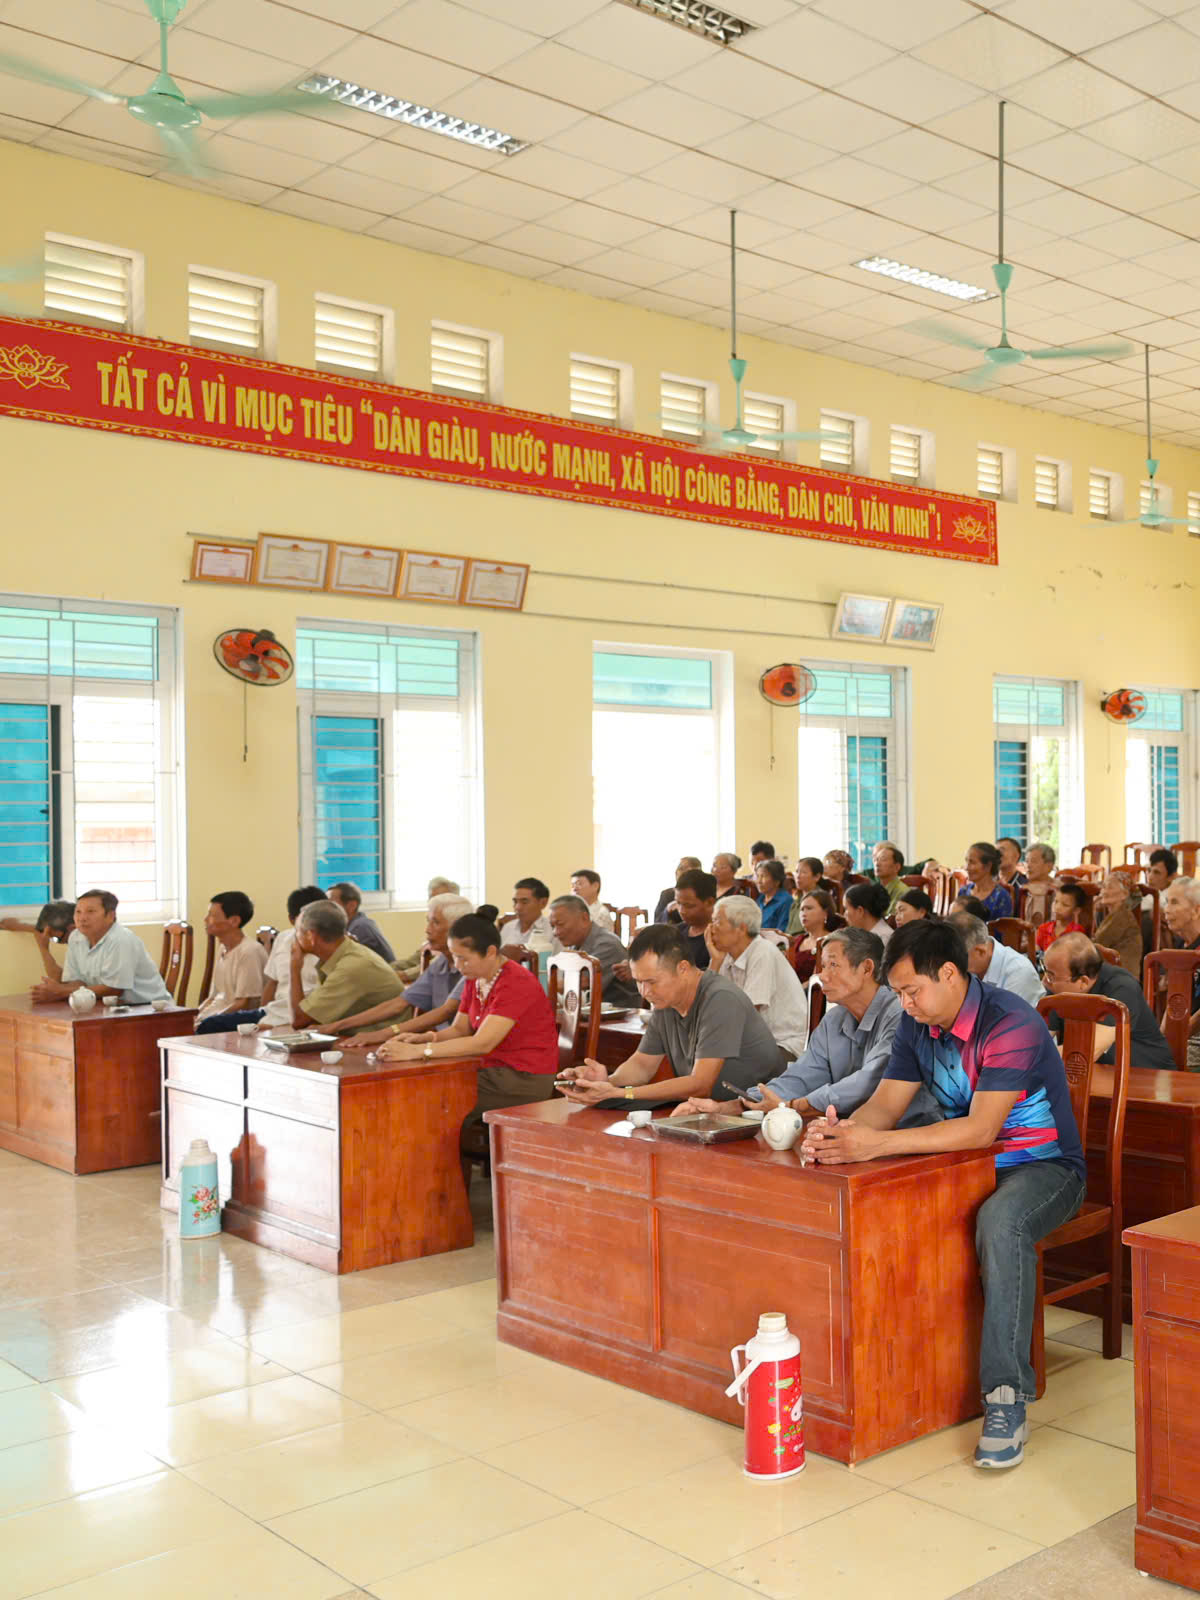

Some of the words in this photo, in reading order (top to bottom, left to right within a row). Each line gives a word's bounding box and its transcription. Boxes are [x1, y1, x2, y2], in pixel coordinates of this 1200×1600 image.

[96, 351, 149, 412] TẤT
[156, 361, 194, 419] CẢ
[201, 373, 227, 425] VÌ
[235, 386, 294, 441] MỤC
[300, 395, 353, 445] TIÊU
[427, 416, 486, 471] GIÀU,
[490, 430, 547, 476] NƯỚC
[552, 442, 616, 492] MẠNH,
[621, 451, 647, 493] XÃ
[651, 456, 680, 504] HỘI
[685, 461, 731, 508] CÔNG
[735, 465, 784, 521] BẰNG,
[787, 481, 820, 522] DÂN
[823, 485, 858, 532] CHỦ,
[861, 495, 890, 534] VĂN
